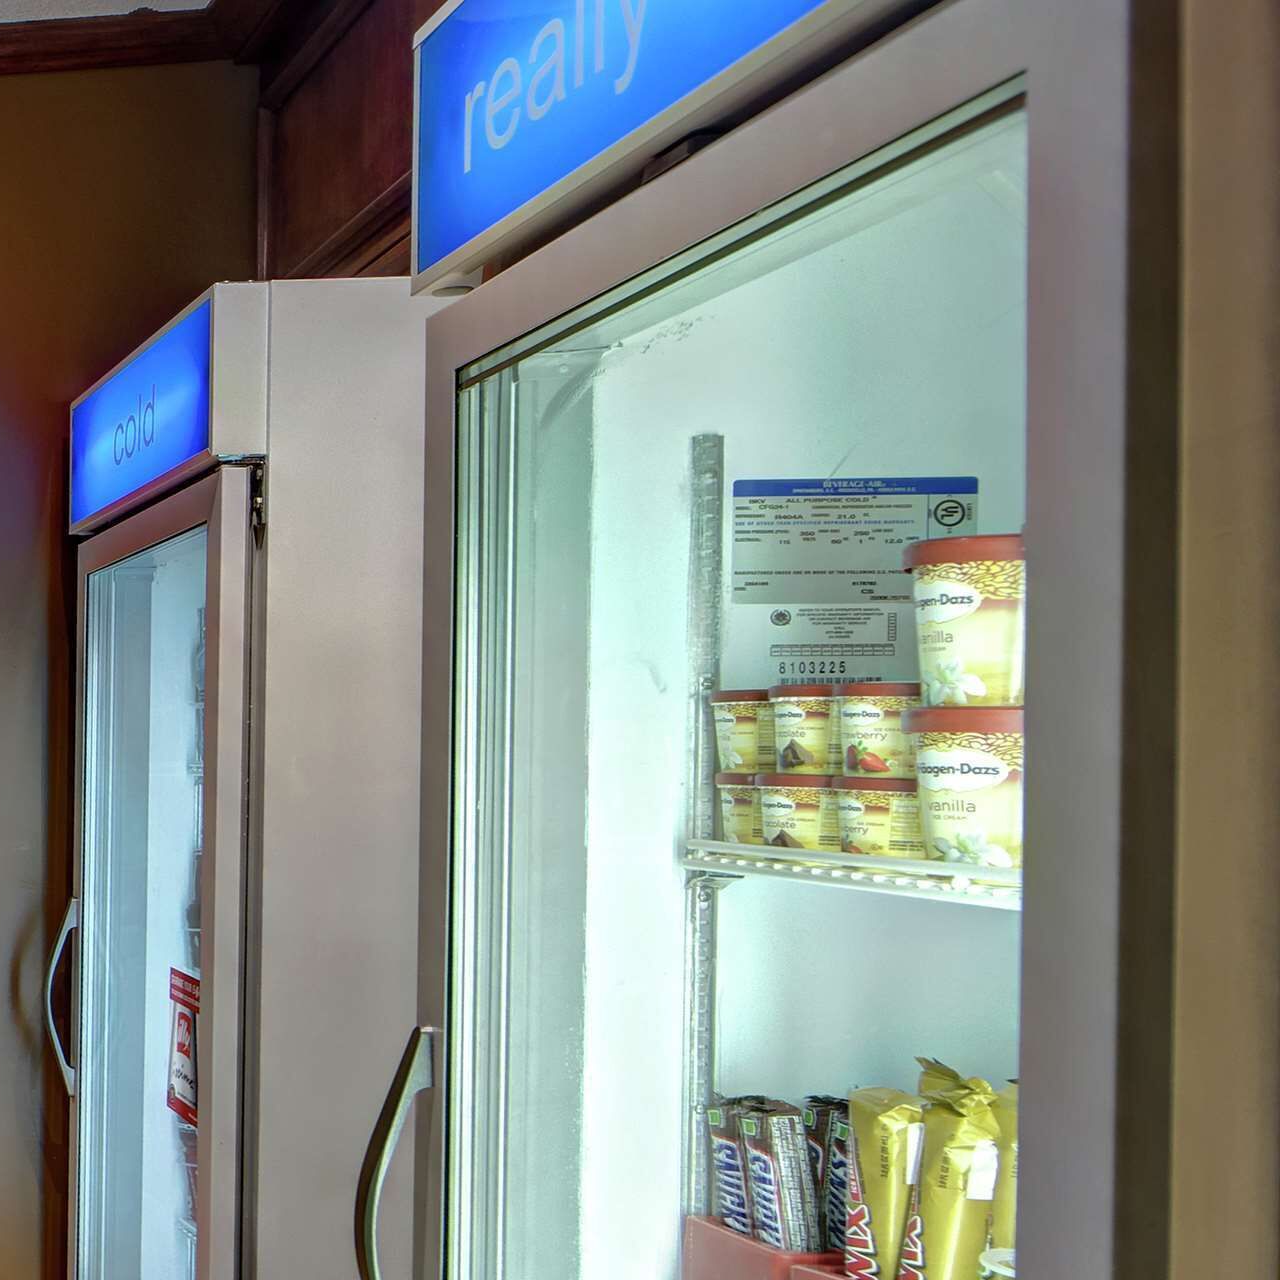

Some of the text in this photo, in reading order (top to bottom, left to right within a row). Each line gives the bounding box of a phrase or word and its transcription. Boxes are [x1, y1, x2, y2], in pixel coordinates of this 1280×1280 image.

[464, 0, 647, 174] really
[113, 383, 155, 466] cold
[778, 660, 847, 674] 8103225
[928, 799, 977, 813] vanilla
